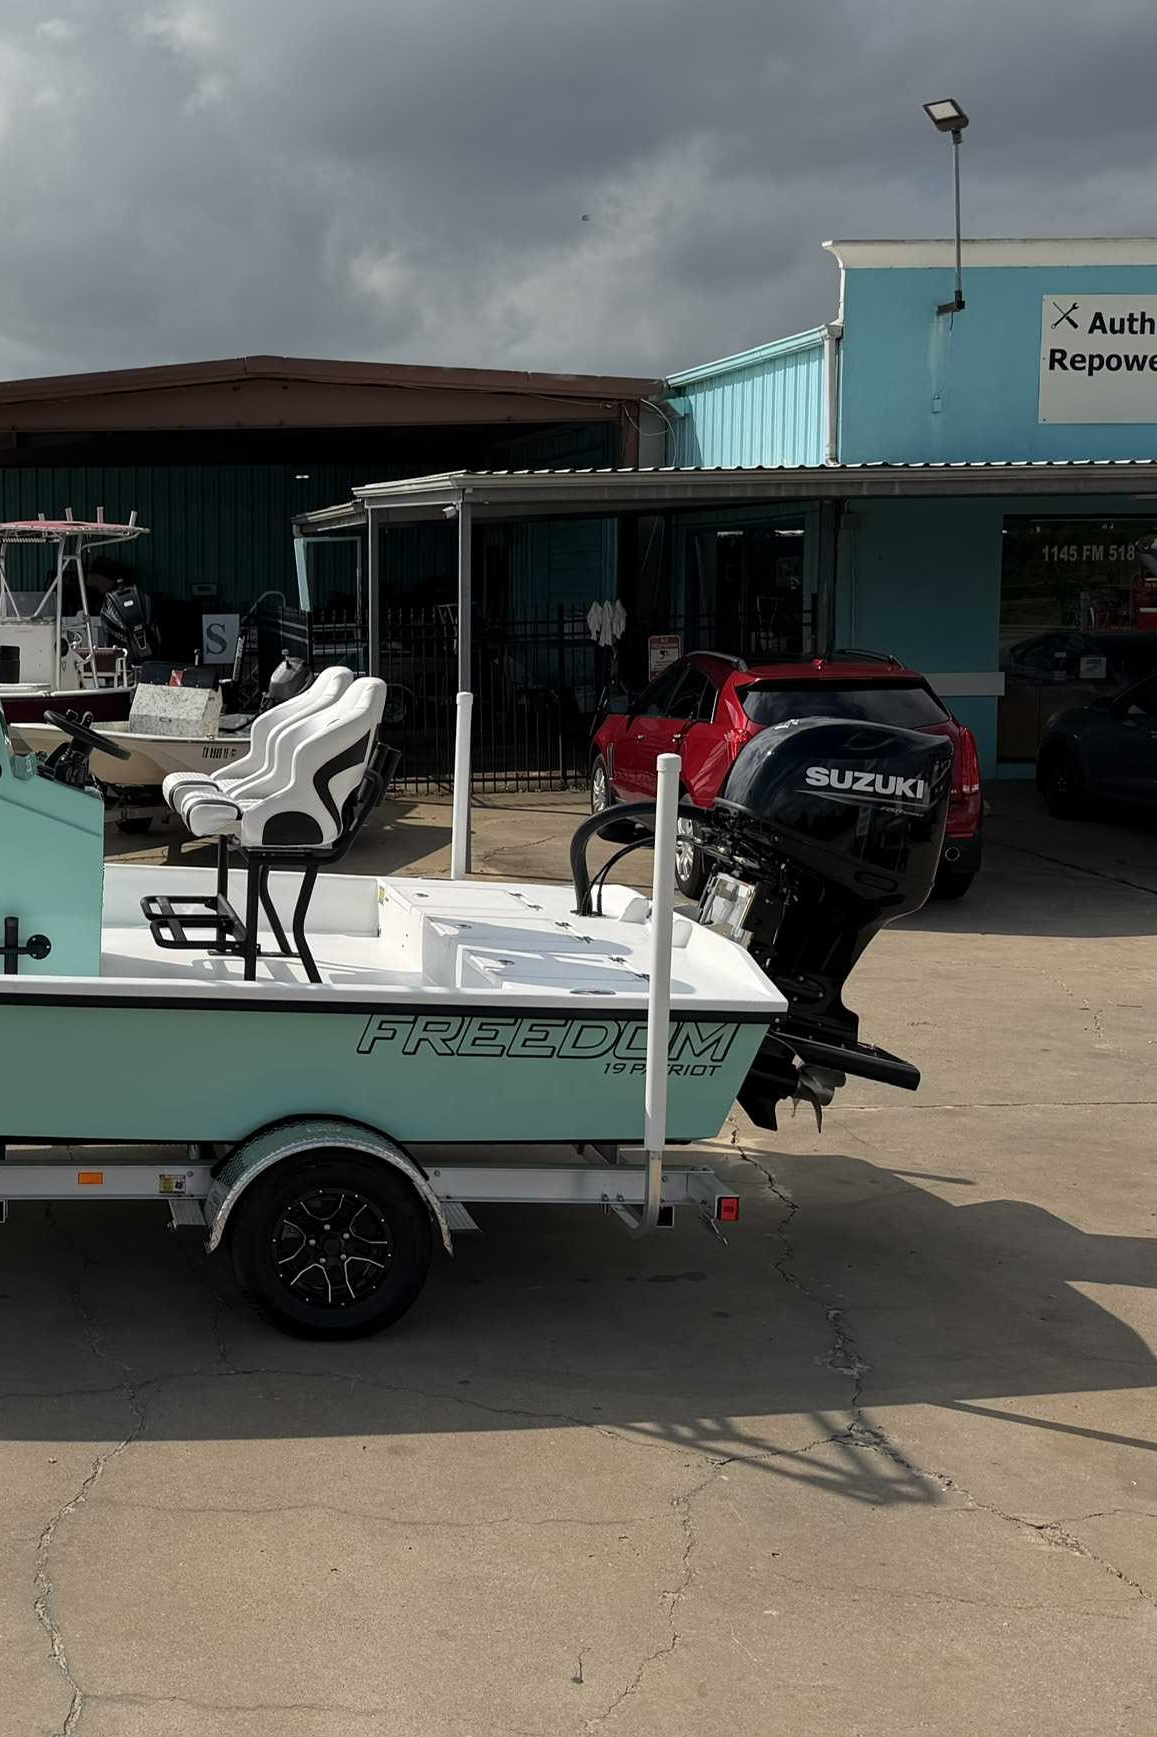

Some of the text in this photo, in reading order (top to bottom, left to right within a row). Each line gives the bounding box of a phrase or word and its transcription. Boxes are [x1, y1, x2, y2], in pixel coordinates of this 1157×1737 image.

[1088, 311, 1156, 335] Auth
[1042, 545, 1136, 561] 1145 FM 518
[205, 622, 228, 655] S
[805, 766, 925, 799] SUZUKI
[356, 1013, 742, 1062] FREEDOM
[603, 1062, 627, 1075] 19
